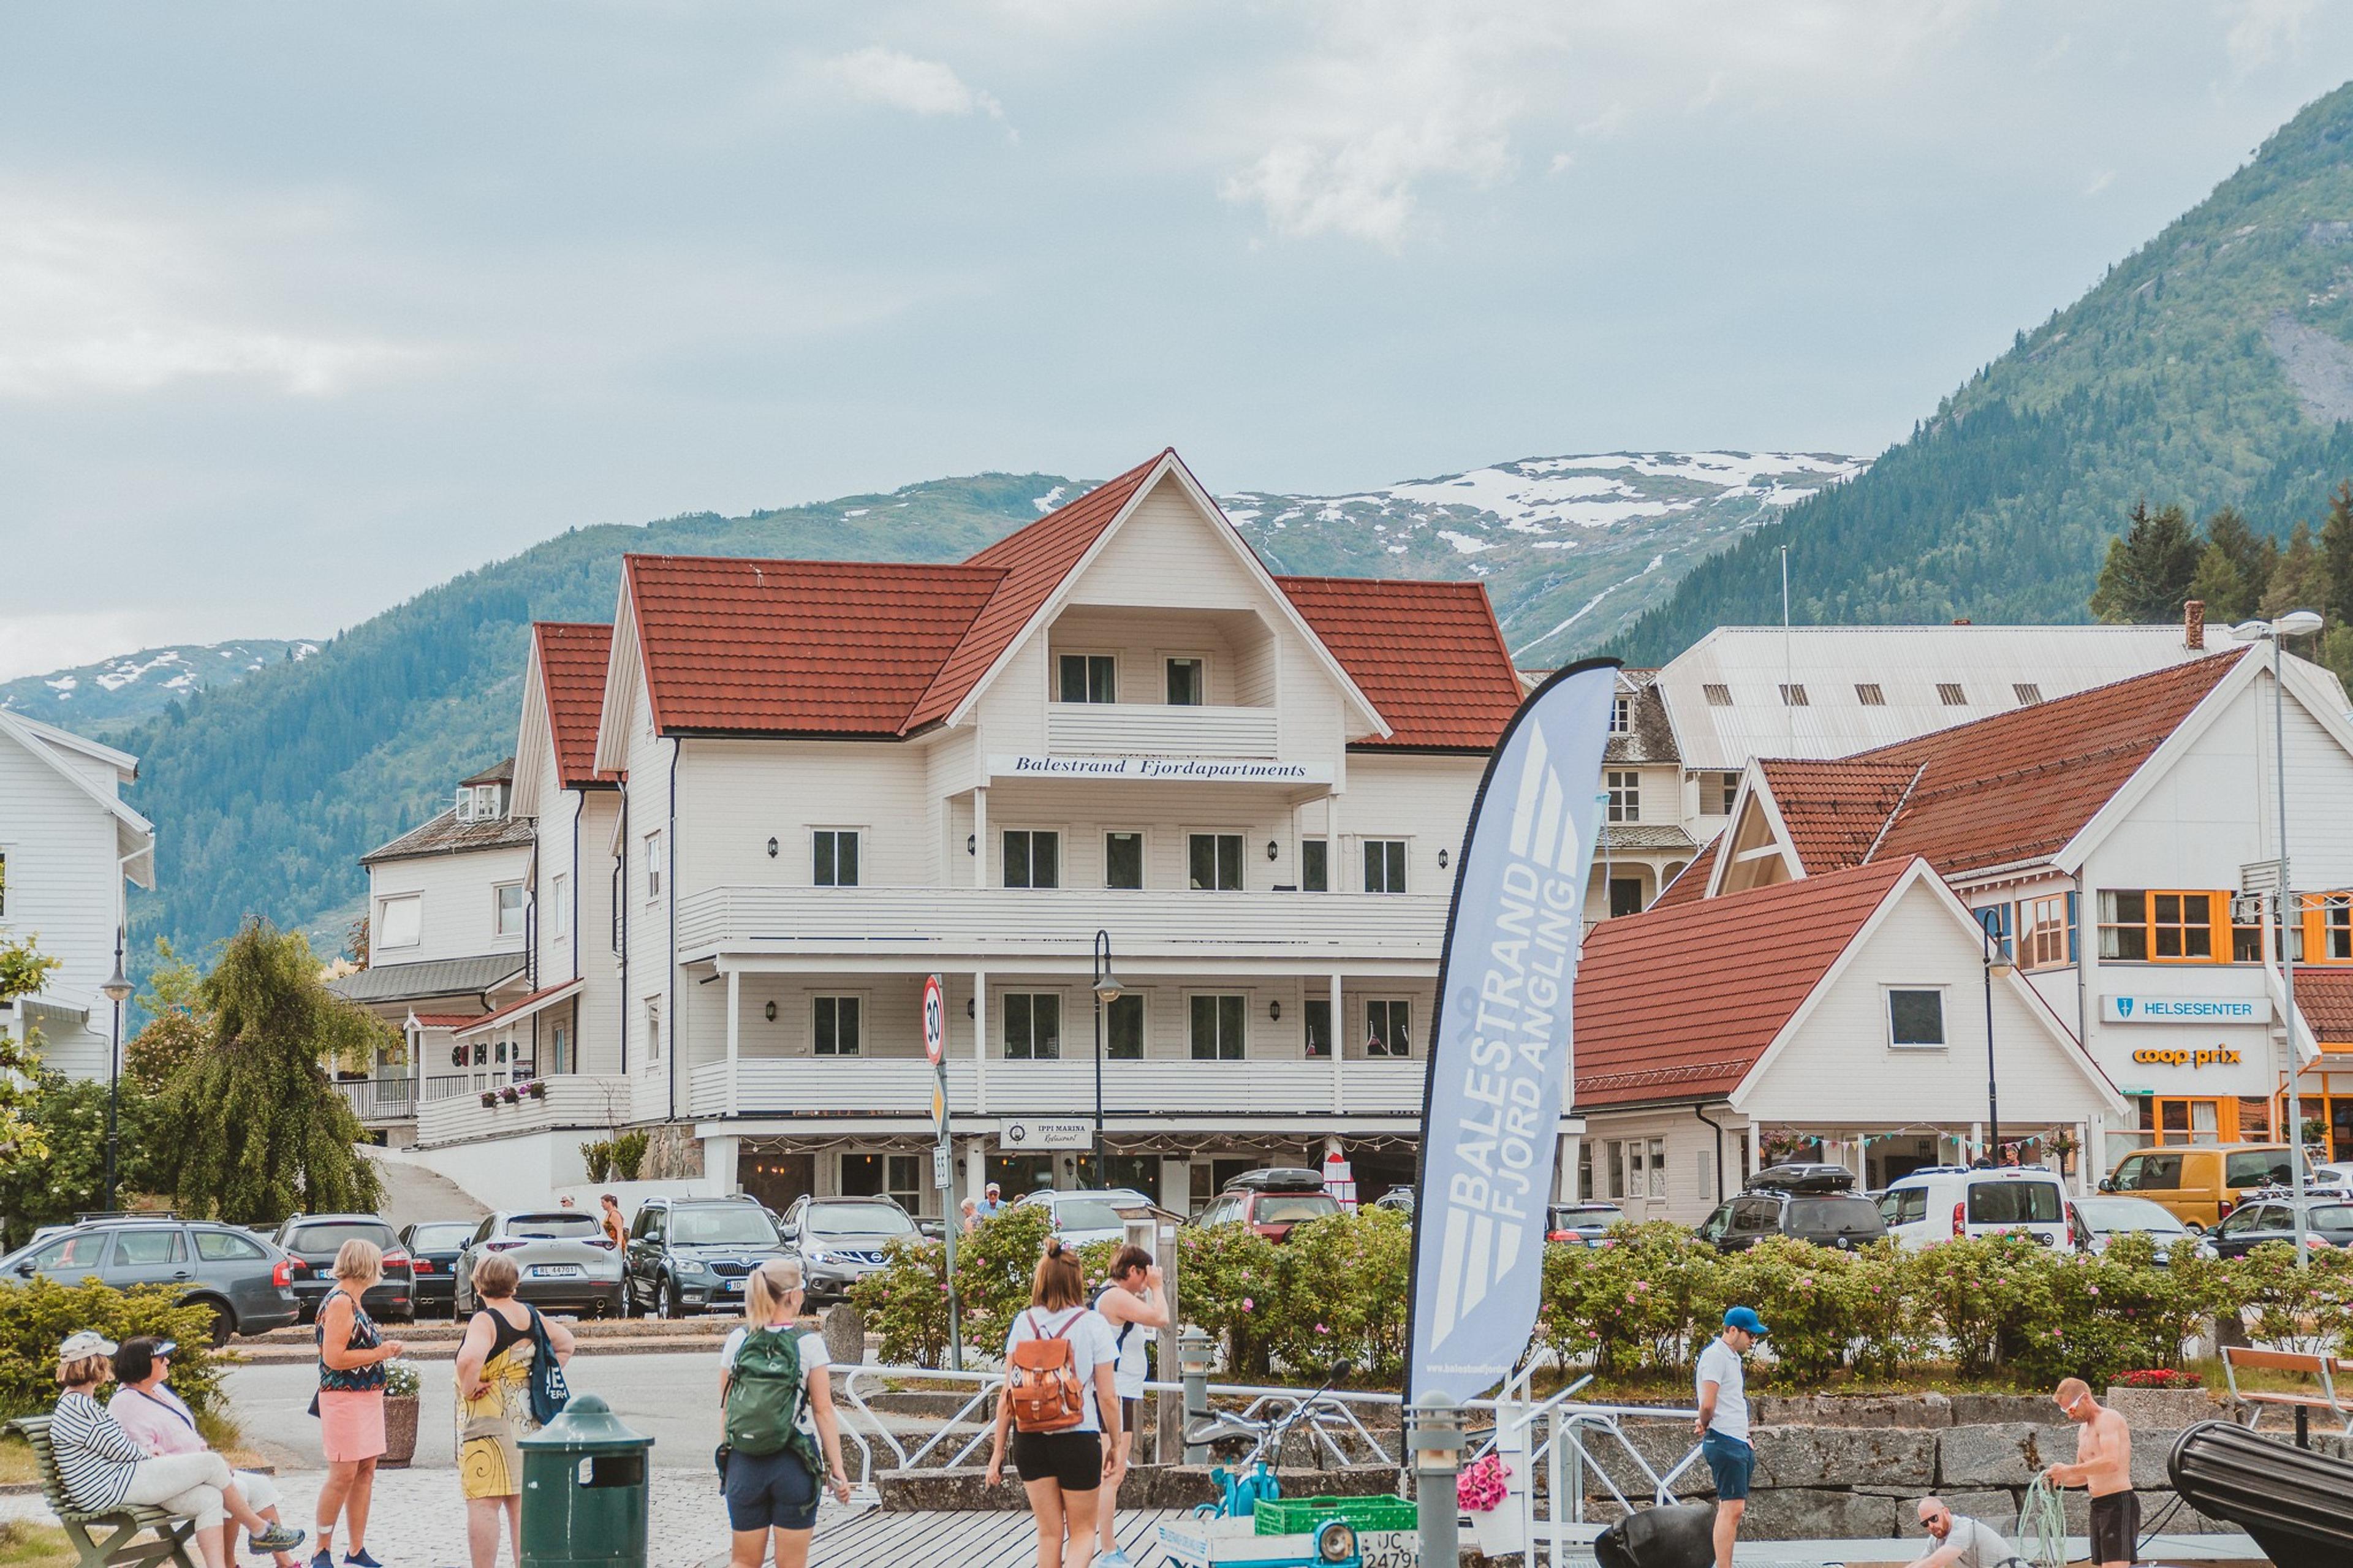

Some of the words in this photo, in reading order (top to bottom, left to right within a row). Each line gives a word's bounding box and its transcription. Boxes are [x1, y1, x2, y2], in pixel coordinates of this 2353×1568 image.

[1016, 757, 1126, 773] Balestrand
[1140, 760, 1307, 778] Fjordapartments
[926, 999, 940, 1043] 30
[2145, 1002, 2253, 1016] HELSESENTER
[1449, 862, 1539, 1211] BALESTRAND
[1491, 1077, 1541, 1220] FJORD
[1518, 878, 1576, 1070] ANGLING
[2132, 1048, 2191, 1067] coop
[2194, 1043, 2242, 1070] prix
[1044, 1133, 1078, 1143] Restaurant
[1366, 1552, 1412, 1568] 2479
